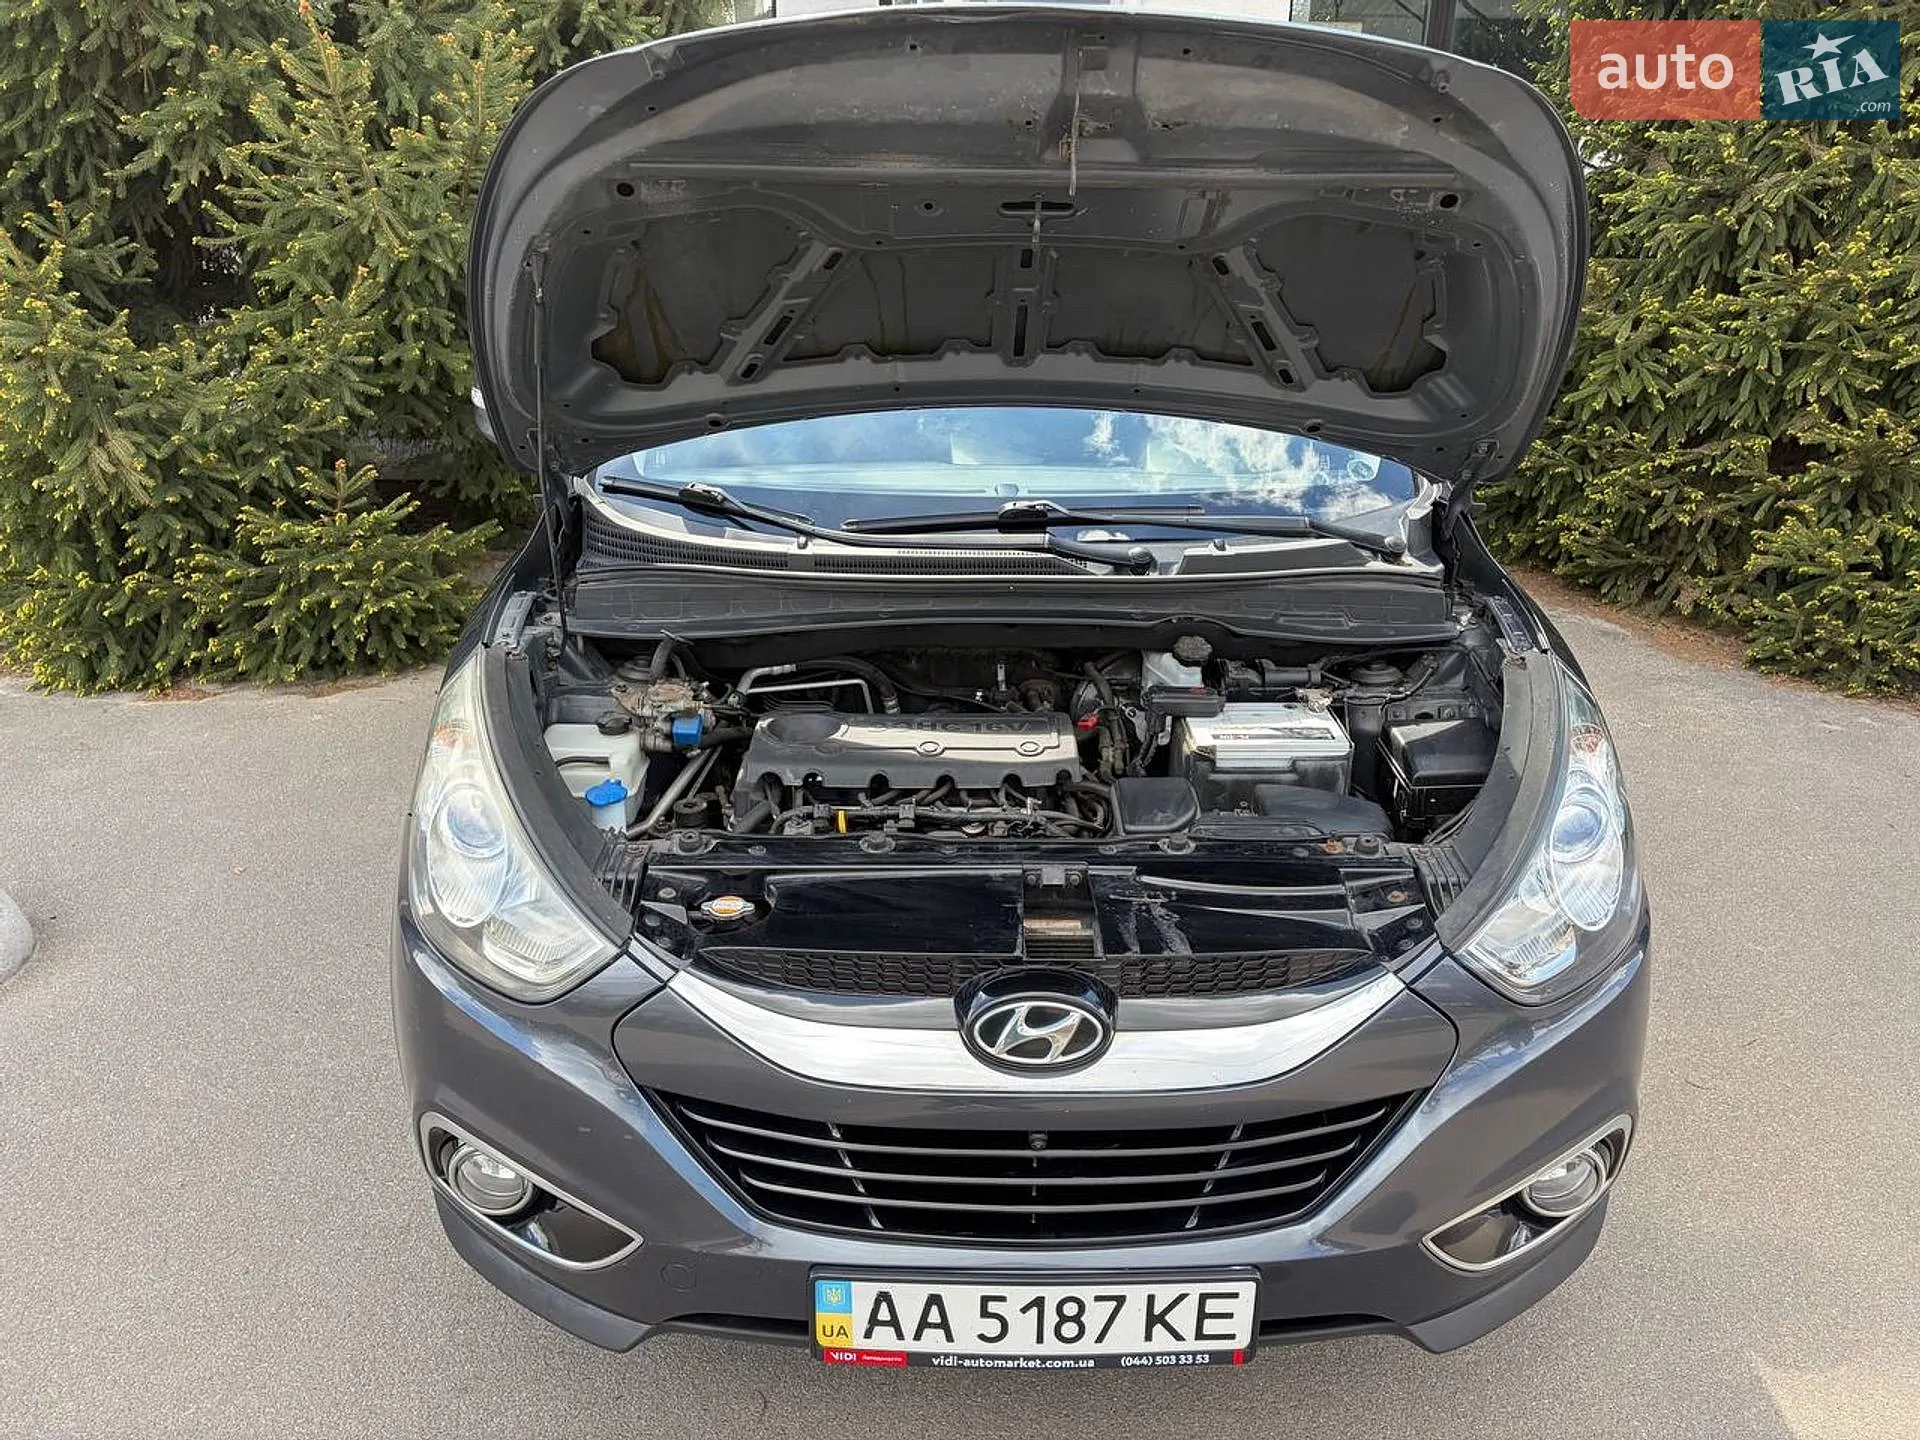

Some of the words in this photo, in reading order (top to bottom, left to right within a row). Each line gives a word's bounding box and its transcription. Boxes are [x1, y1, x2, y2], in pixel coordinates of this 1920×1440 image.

[863, 1291, 955, 1343] AA
[977, 1294, 1127, 1344] 5187
[1144, 1292, 1240, 1342] KE
[822, 1325, 849, 1339] UA
[829, 1351, 857, 1361] VIDI
[931, 1355, 1095, 1369] vidi-automarket.com.ua
[1120, 1355, 1153, 1367] (044)
[1155, 1354, 1177, 1365] 503
[1179, 1354, 1194, 1365] 33
[1195, 1354, 1210, 1364] 53
